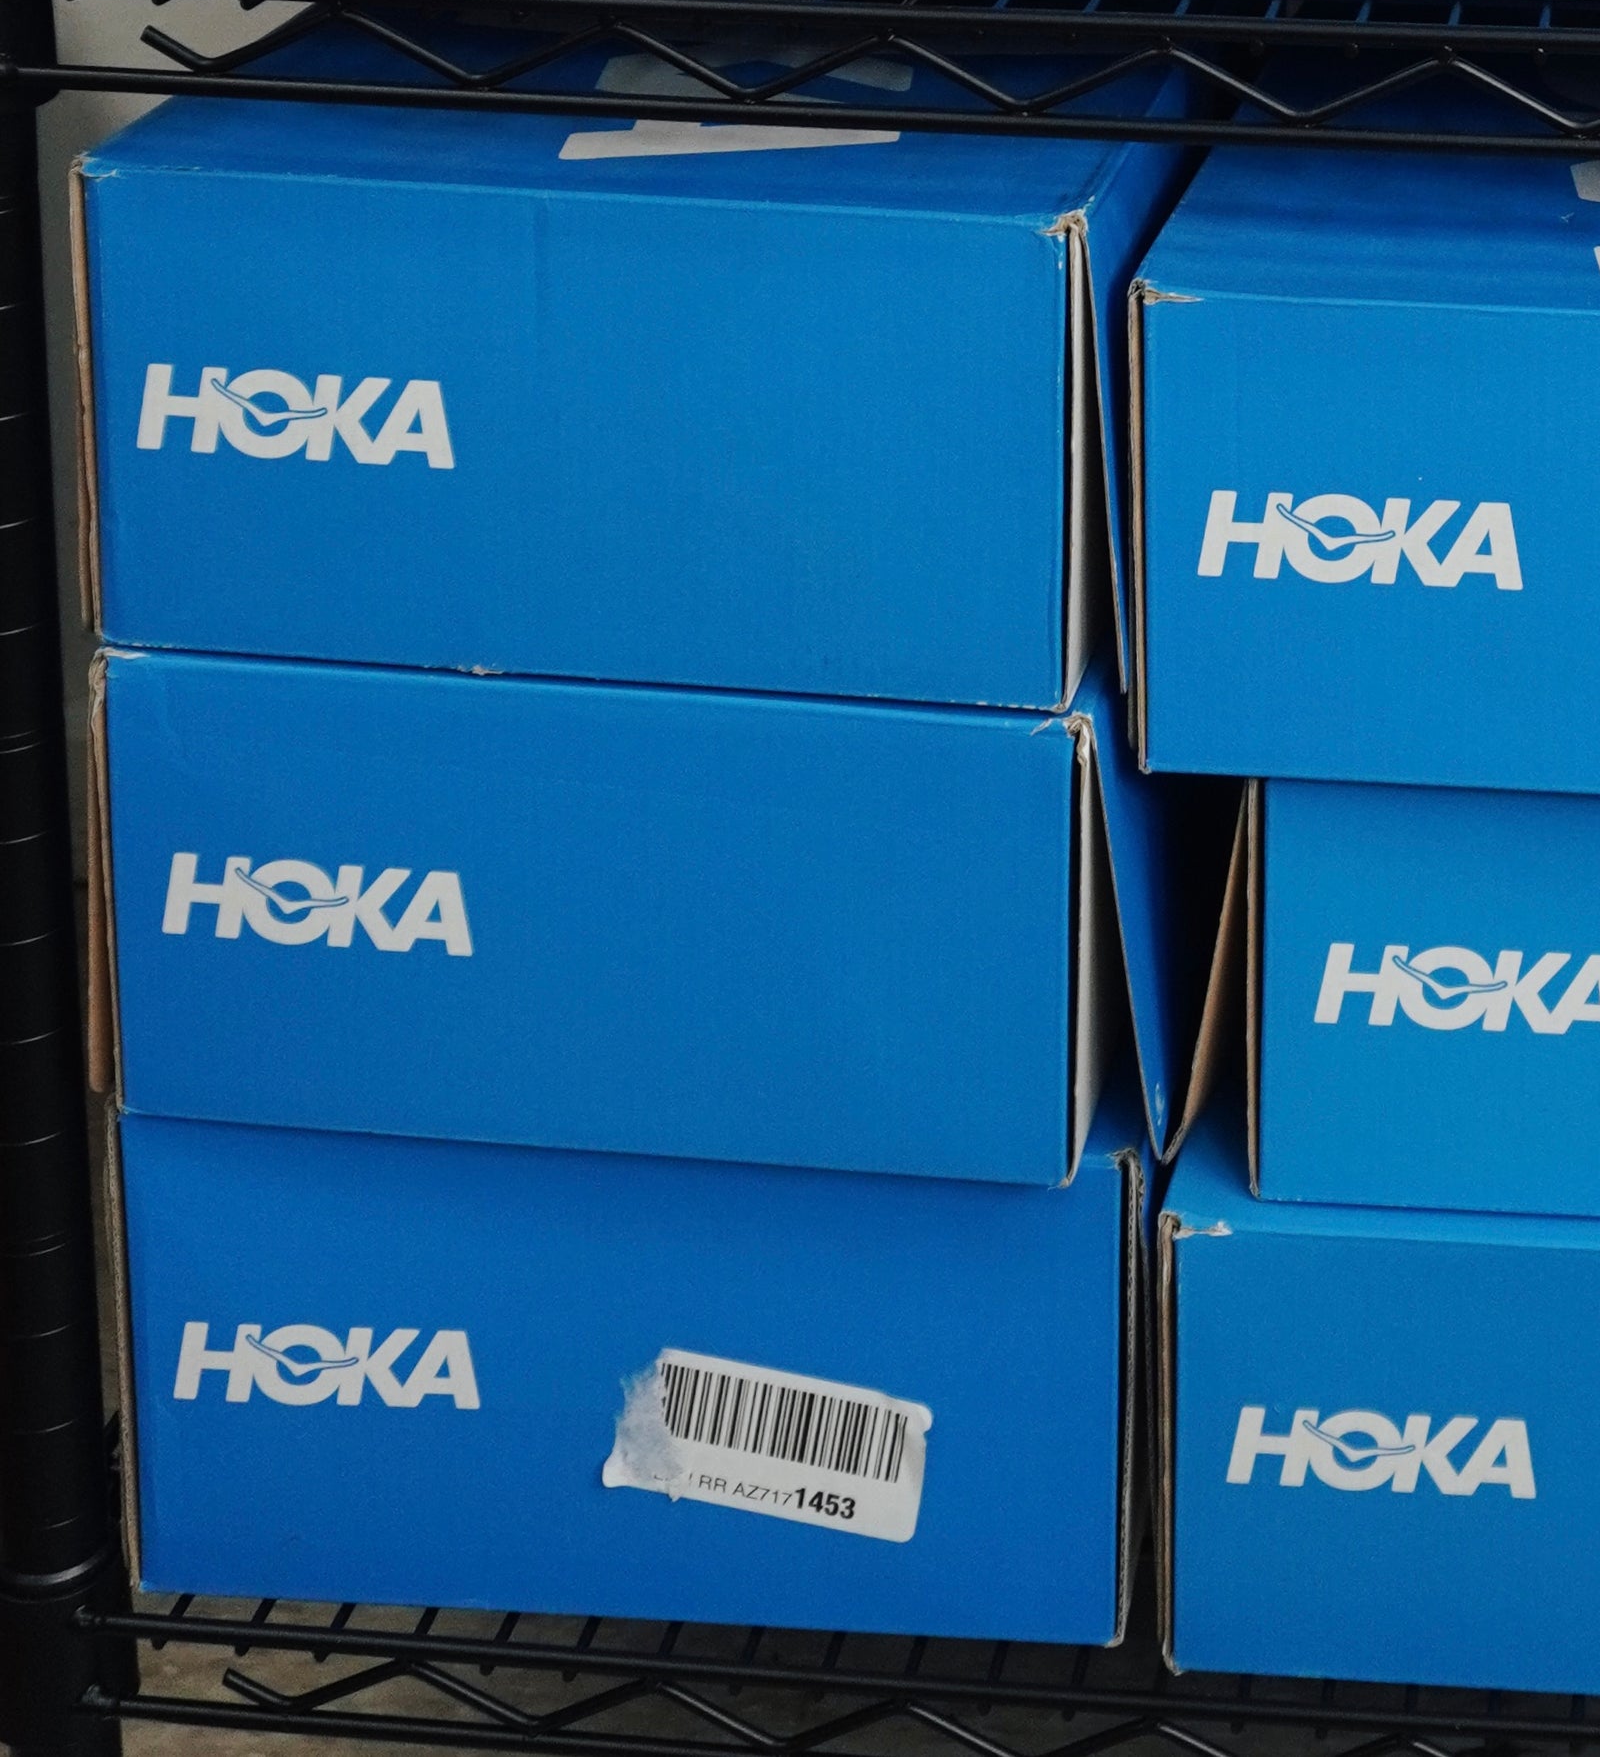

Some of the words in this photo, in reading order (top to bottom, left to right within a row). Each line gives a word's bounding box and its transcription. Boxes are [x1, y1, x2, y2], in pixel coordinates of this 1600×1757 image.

[137, 363, 454, 469] HOKA
[1197, 490, 1523, 591] HOKA
[162, 852, 473, 957] HOKA
[173, 1321, 480, 1410] HOKA
[1226, 1406, 1536, 1499] HOKA
